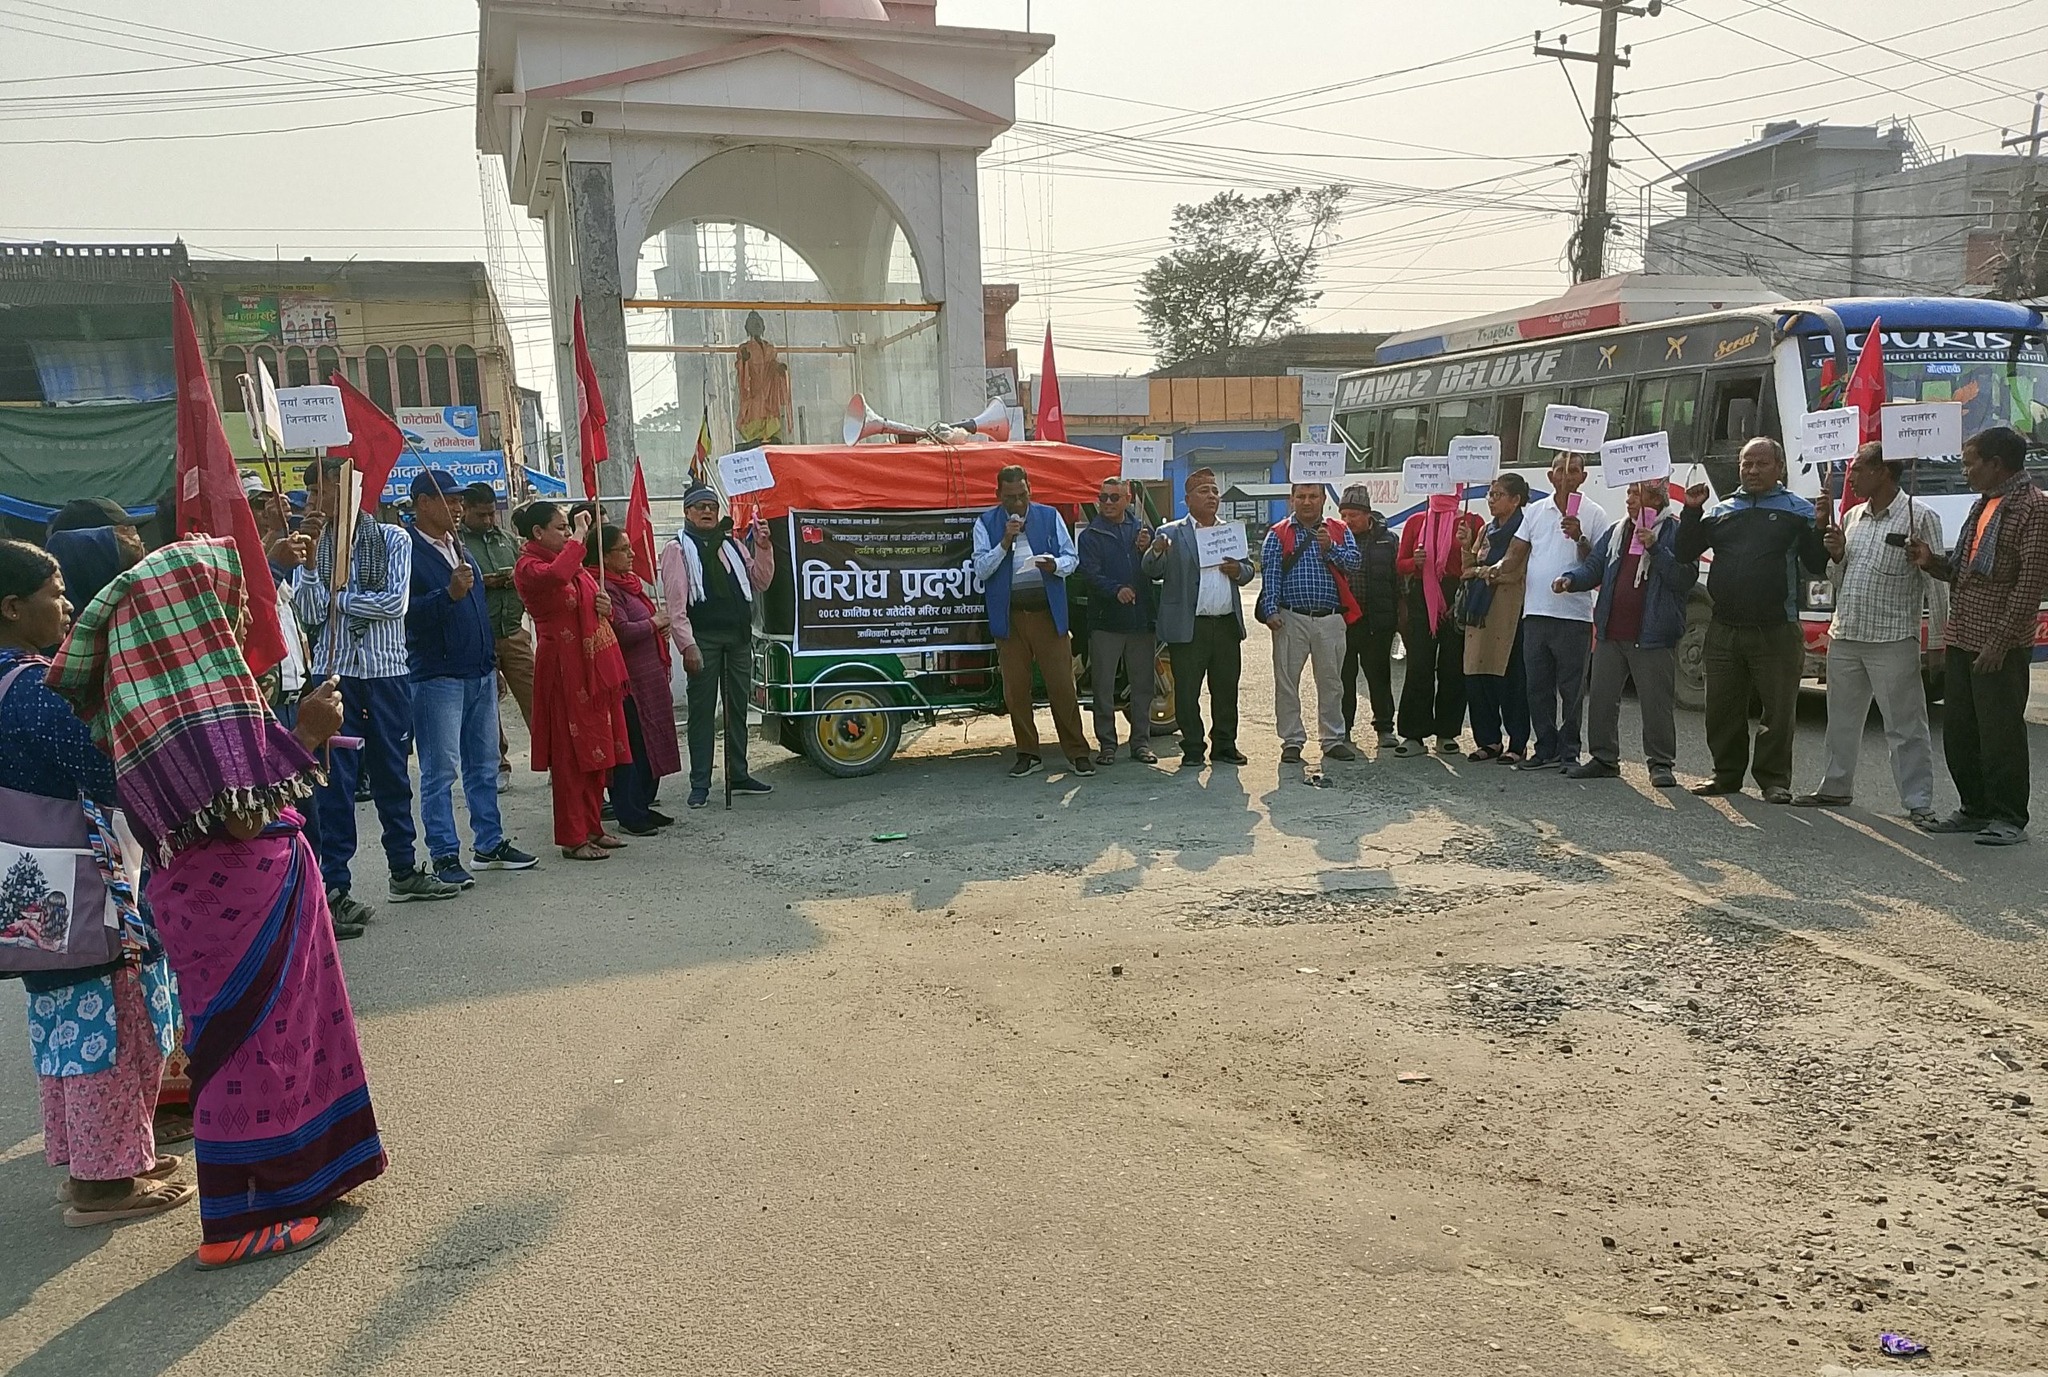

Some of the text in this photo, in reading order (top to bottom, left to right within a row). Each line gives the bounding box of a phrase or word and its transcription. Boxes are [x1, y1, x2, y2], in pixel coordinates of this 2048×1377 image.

[1341, 369, 1432, 406] NAWAZ
[1437, 349, 1562, 394] DELUXE
[302, 396, 335, 407] जनवाद
[402, 413, 443, 426] फोटोकपी
[433, 436, 476, 448] लेमिनेशन
[446, 459, 499, 478] स्टेशनरी
[801, 559, 890, 601] विरोध
[818, 608, 840, 619] २०८२
[842, 605, 871, 618] कार्तिक
[872, 608, 883, 618] २८
[885, 604, 916, 618] गतेदेखि
[917, 603, 939, 617] मंसिर
